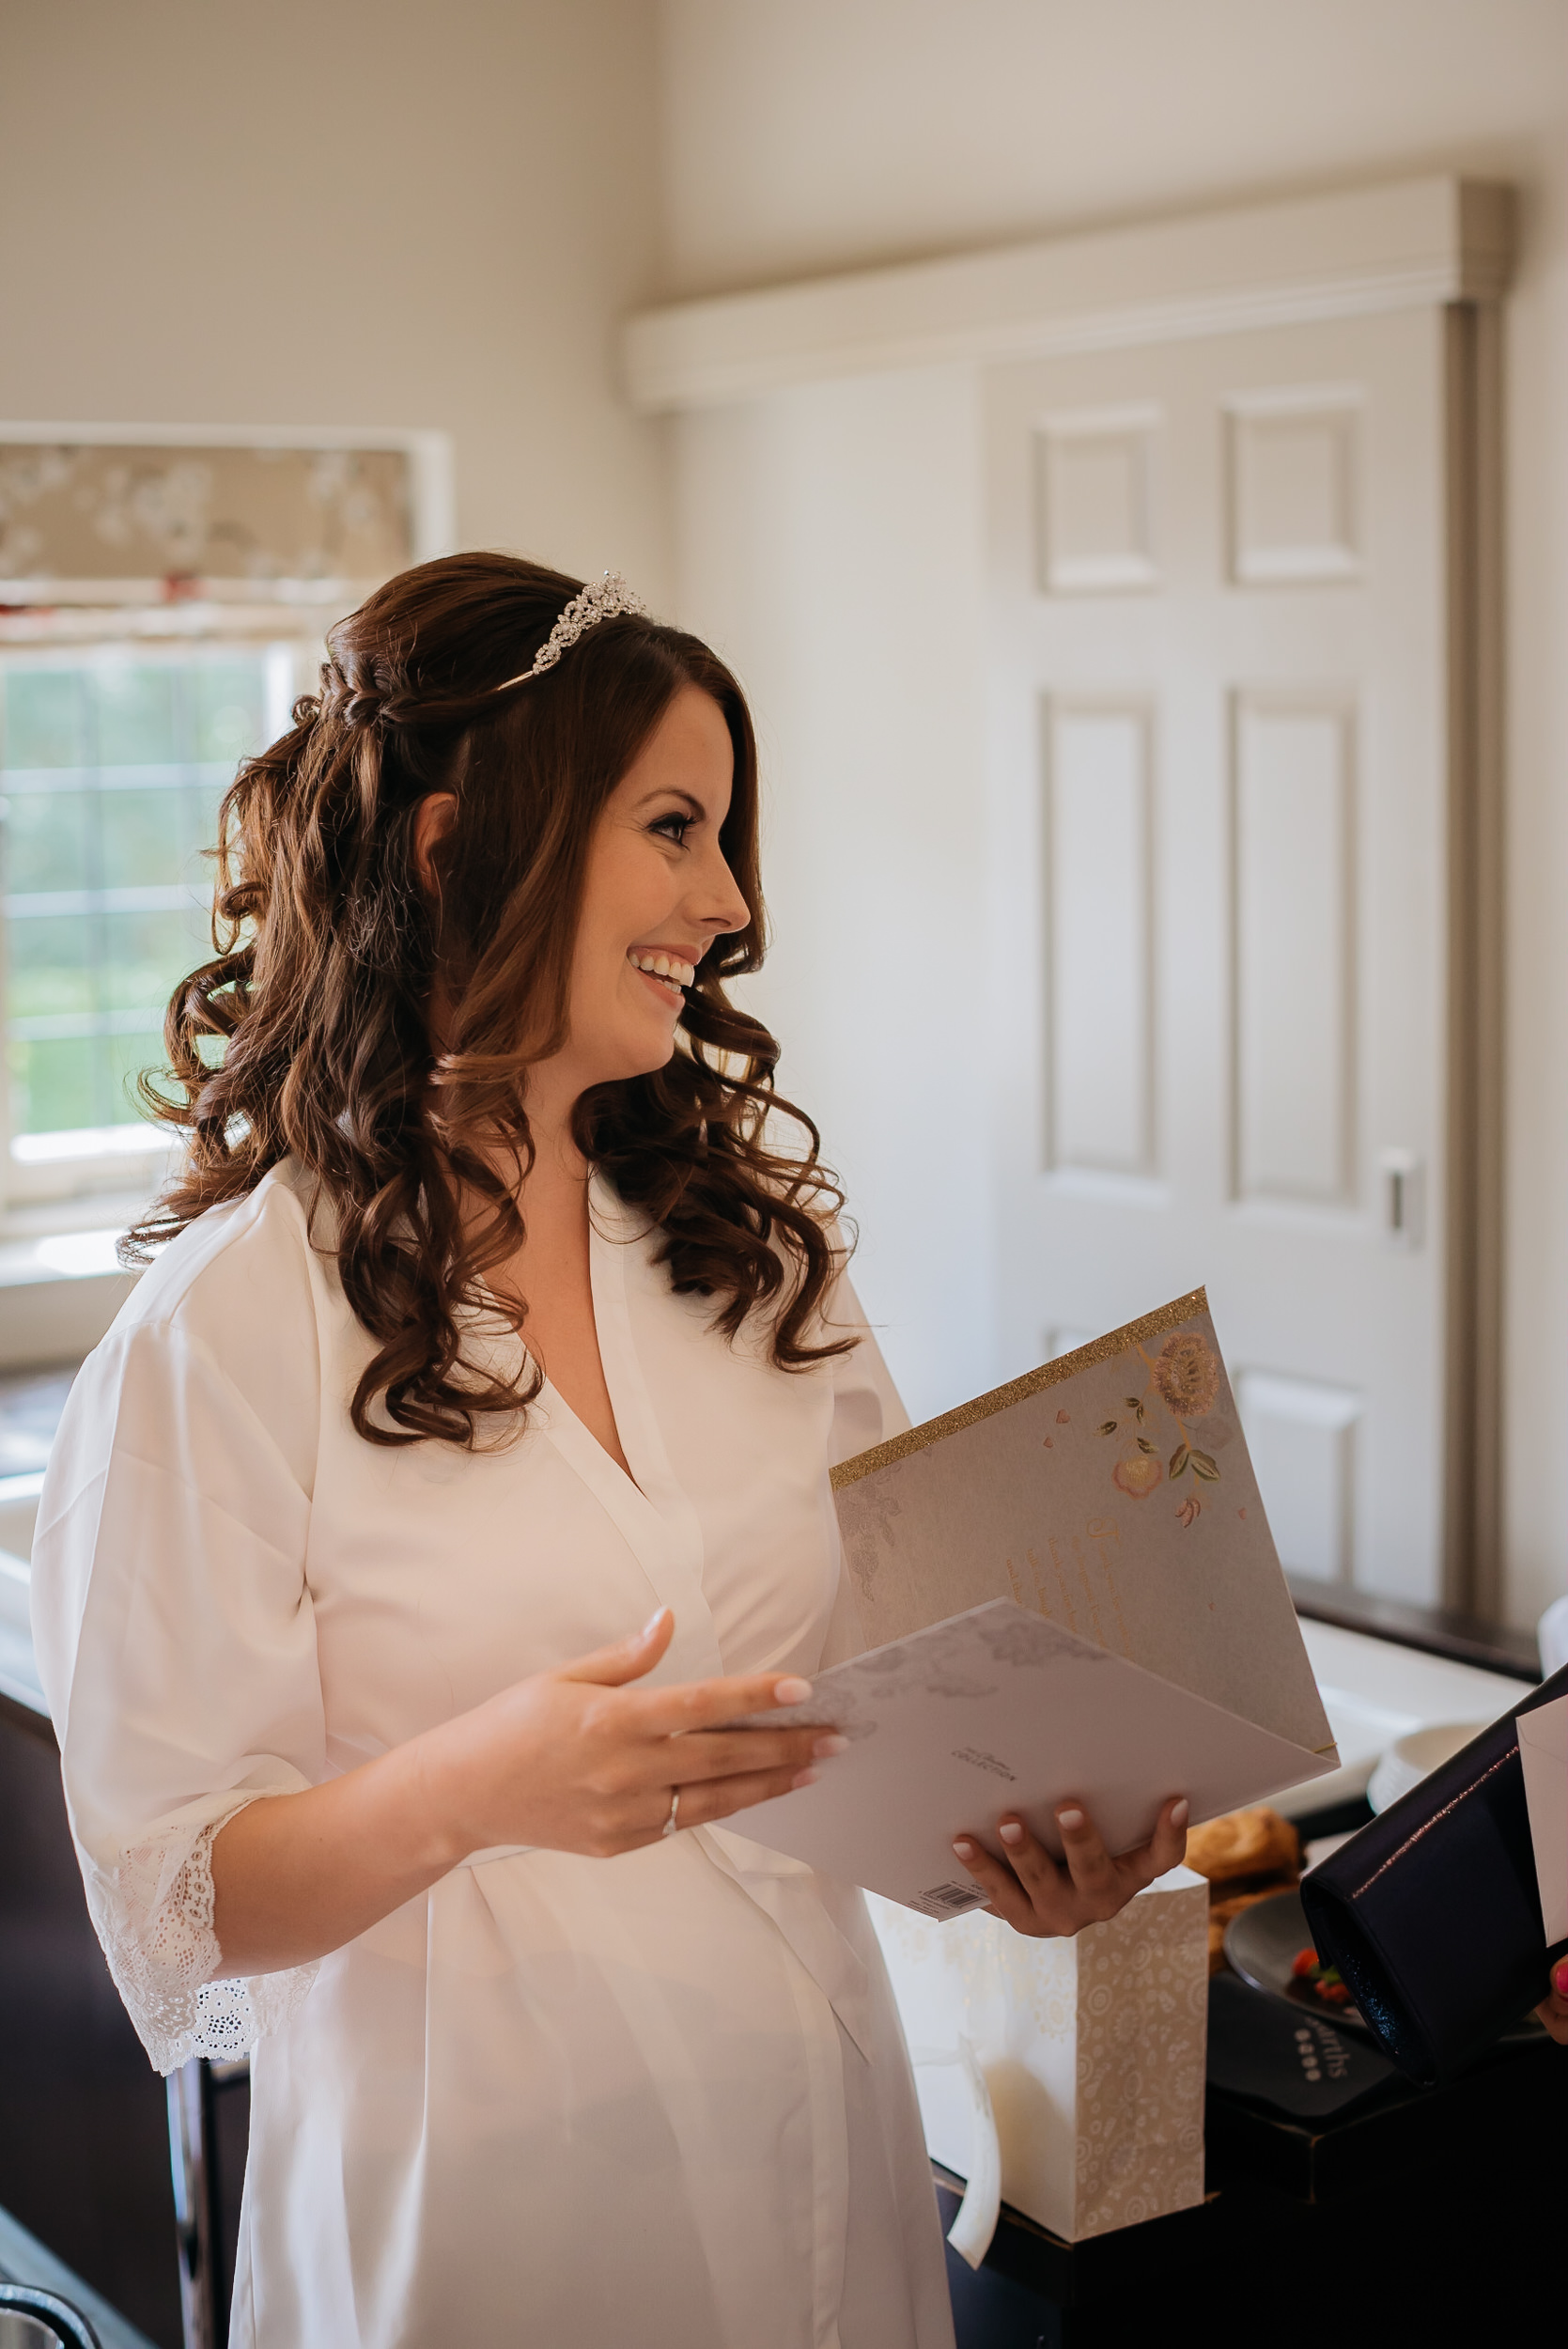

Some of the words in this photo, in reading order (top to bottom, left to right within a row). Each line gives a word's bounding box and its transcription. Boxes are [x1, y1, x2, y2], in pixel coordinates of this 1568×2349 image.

[1048, 1536, 1063, 1569] thank
[1006, 1559, 1018, 1579] and
[1055, 1572, 1066, 1594] you
